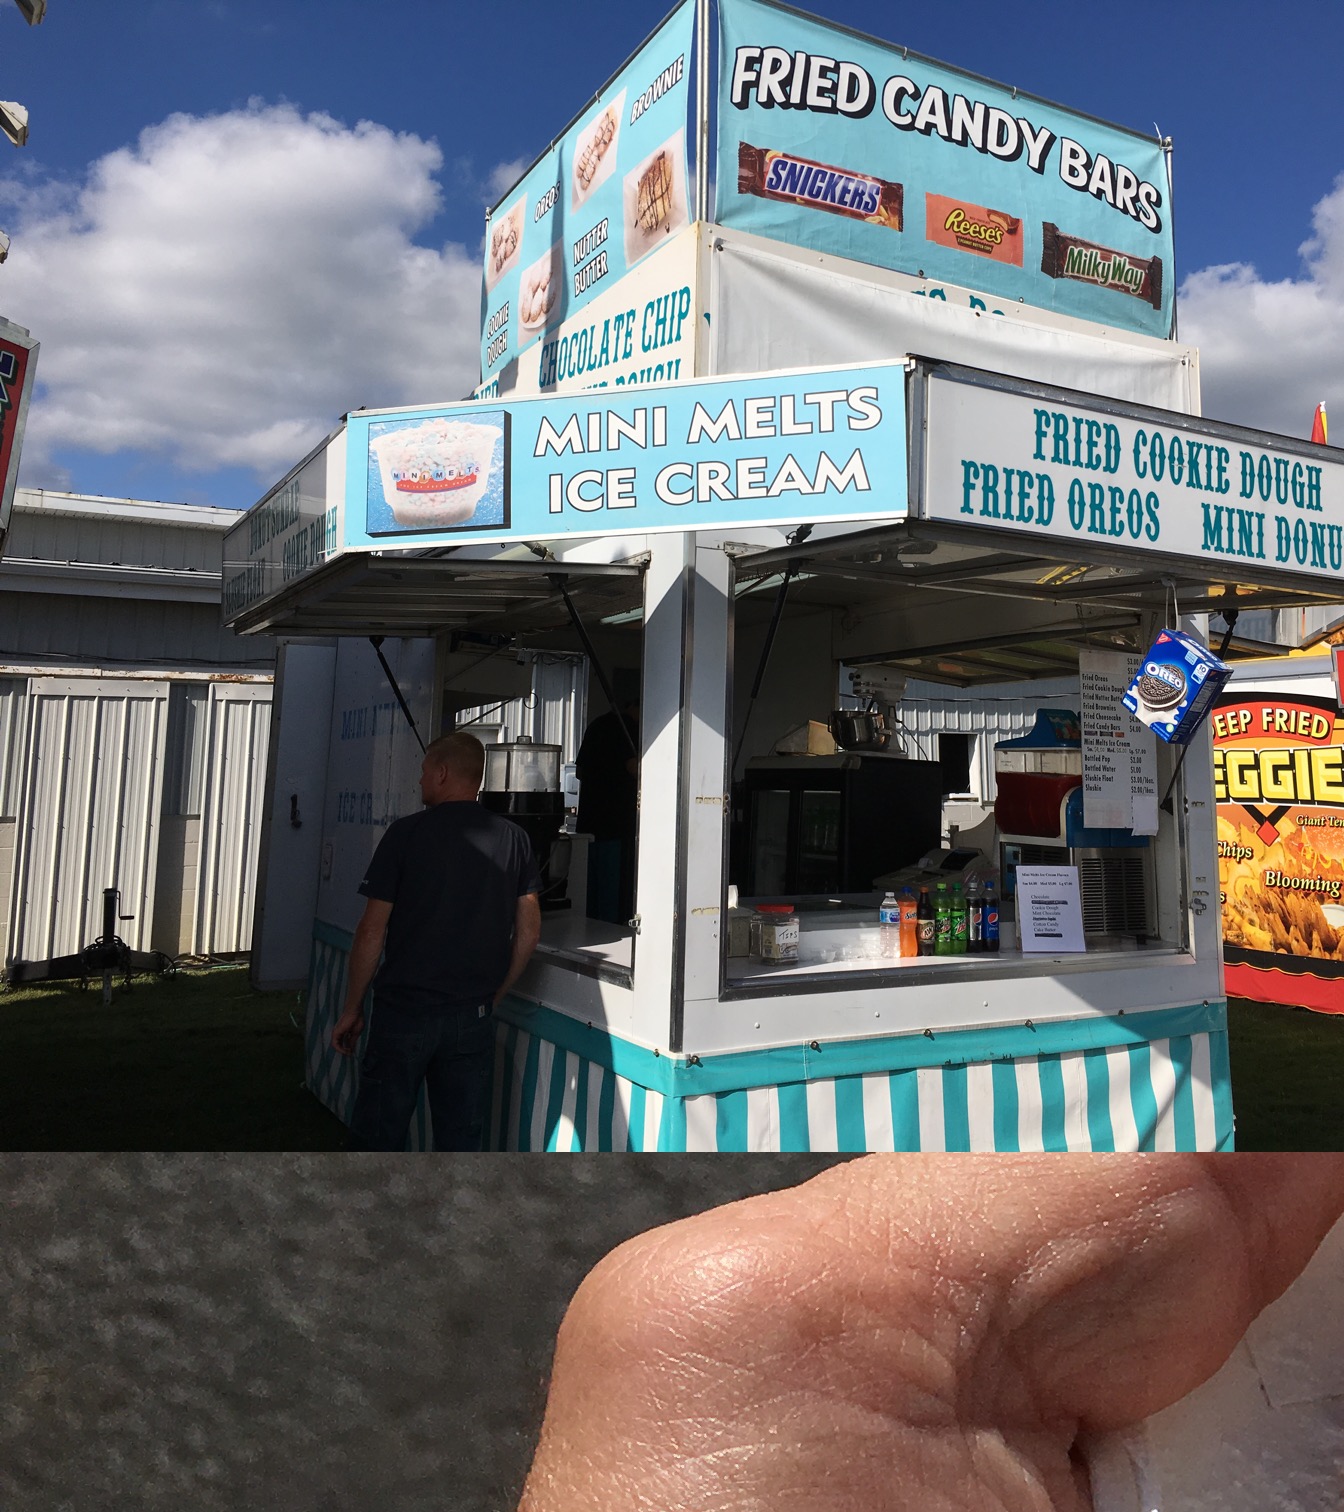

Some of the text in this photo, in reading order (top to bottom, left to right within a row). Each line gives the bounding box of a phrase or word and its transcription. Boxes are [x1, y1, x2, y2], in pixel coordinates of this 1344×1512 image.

[630, 53, 684, 126] BROWNIE
[730, 46, 1163, 234] FRIED CANDY BARS
[766, 158, 881, 214] SNICKERS
[573, 218, 608, 267] NUTTER
[944, 208, 1004, 245] Reese's
[574, 250, 608, 298] BUTTER
[1064, 247, 1145, 294] Milky Way
[538, 286, 691, 389] CHOCOLATE CHIP
[533, 386, 883, 457] MINI MELTS
[1033, 408, 1323, 512] FRIED COOKIE DOUGH
[549, 448, 872, 514] ICE CREAM
[960, 460, 1055, 526] FRIED
[1067, 478, 1160, 542] OREOS
[1201, 503, 1266, 559] MINI
[1082, 683, 1125, 694] Fried Cookie Dough
[1145, 661, 1182, 690] OREO
[1095, 694, 1110, 702] Nutter
[1096, 703, 1116, 711] Brownies
[1083, 712, 1095, 720] Fried
[1096, 713, 1121, 721] Cheesecake
[1096, 723, 1110, 731] Candy
[1212, 708, 1330, 741] EEP FRIED
[1084, 754, 1100, 762] Bottled
[1102, 755, 1110, 764] Pop
[1095, 739, 1108, 747] Melts
[1085, 764, 1101, 772] Bottled
[1102, 765, 1116, 773] Water
[1085, 774, 1101, 782] Slushie
[337, 791, 356, 823] ICE
[1296, 815, 1327, 827] Giant
[1265, 870, 1341, 897] Blooming
